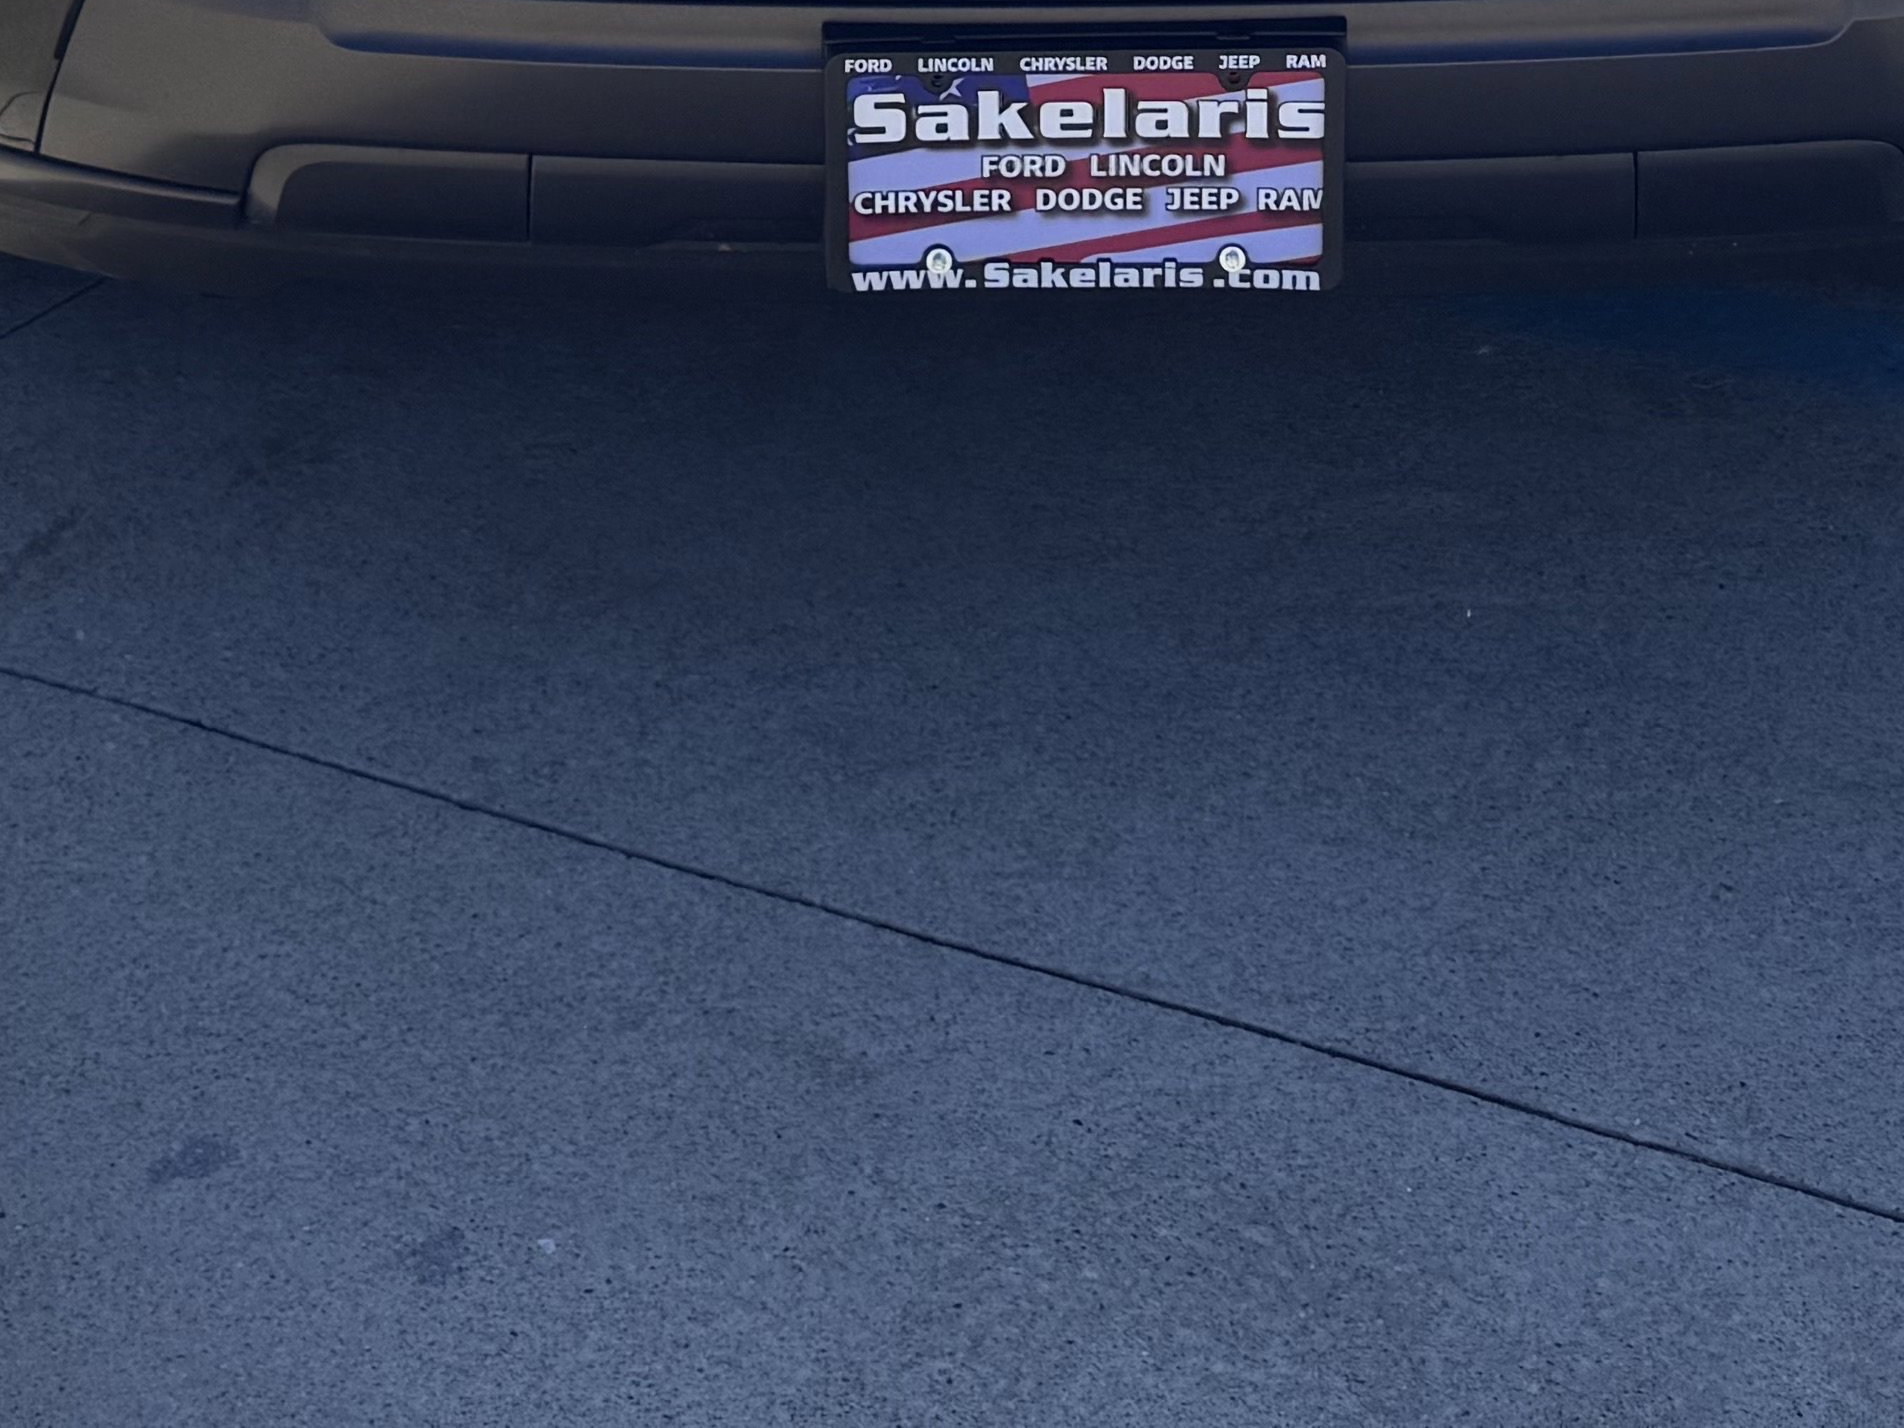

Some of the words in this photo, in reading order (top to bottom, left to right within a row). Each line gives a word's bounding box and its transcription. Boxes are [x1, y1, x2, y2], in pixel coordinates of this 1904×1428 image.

[844, 58, 893, 73] FORD
[917, 57, 994, 72] LINCOLN
[1019, 56, 1108, 72] CHRYSLER
[1133, 55, 1194, 70] DODGE
[1218, 54, 1261, 70] JEEP
[1285, 54, 1327, 69] RAM
[852, 87, 1326, 144] Sakelaris
[981, 154, 1067, 179] FORD
[1089, 153, 1227, 178] LINCOLN
[853, 188, 1012, 215] CHRYSLER
[1036, 187, 1144, 211] DODGE
[1165, 187, 1241, 211] JEEP
